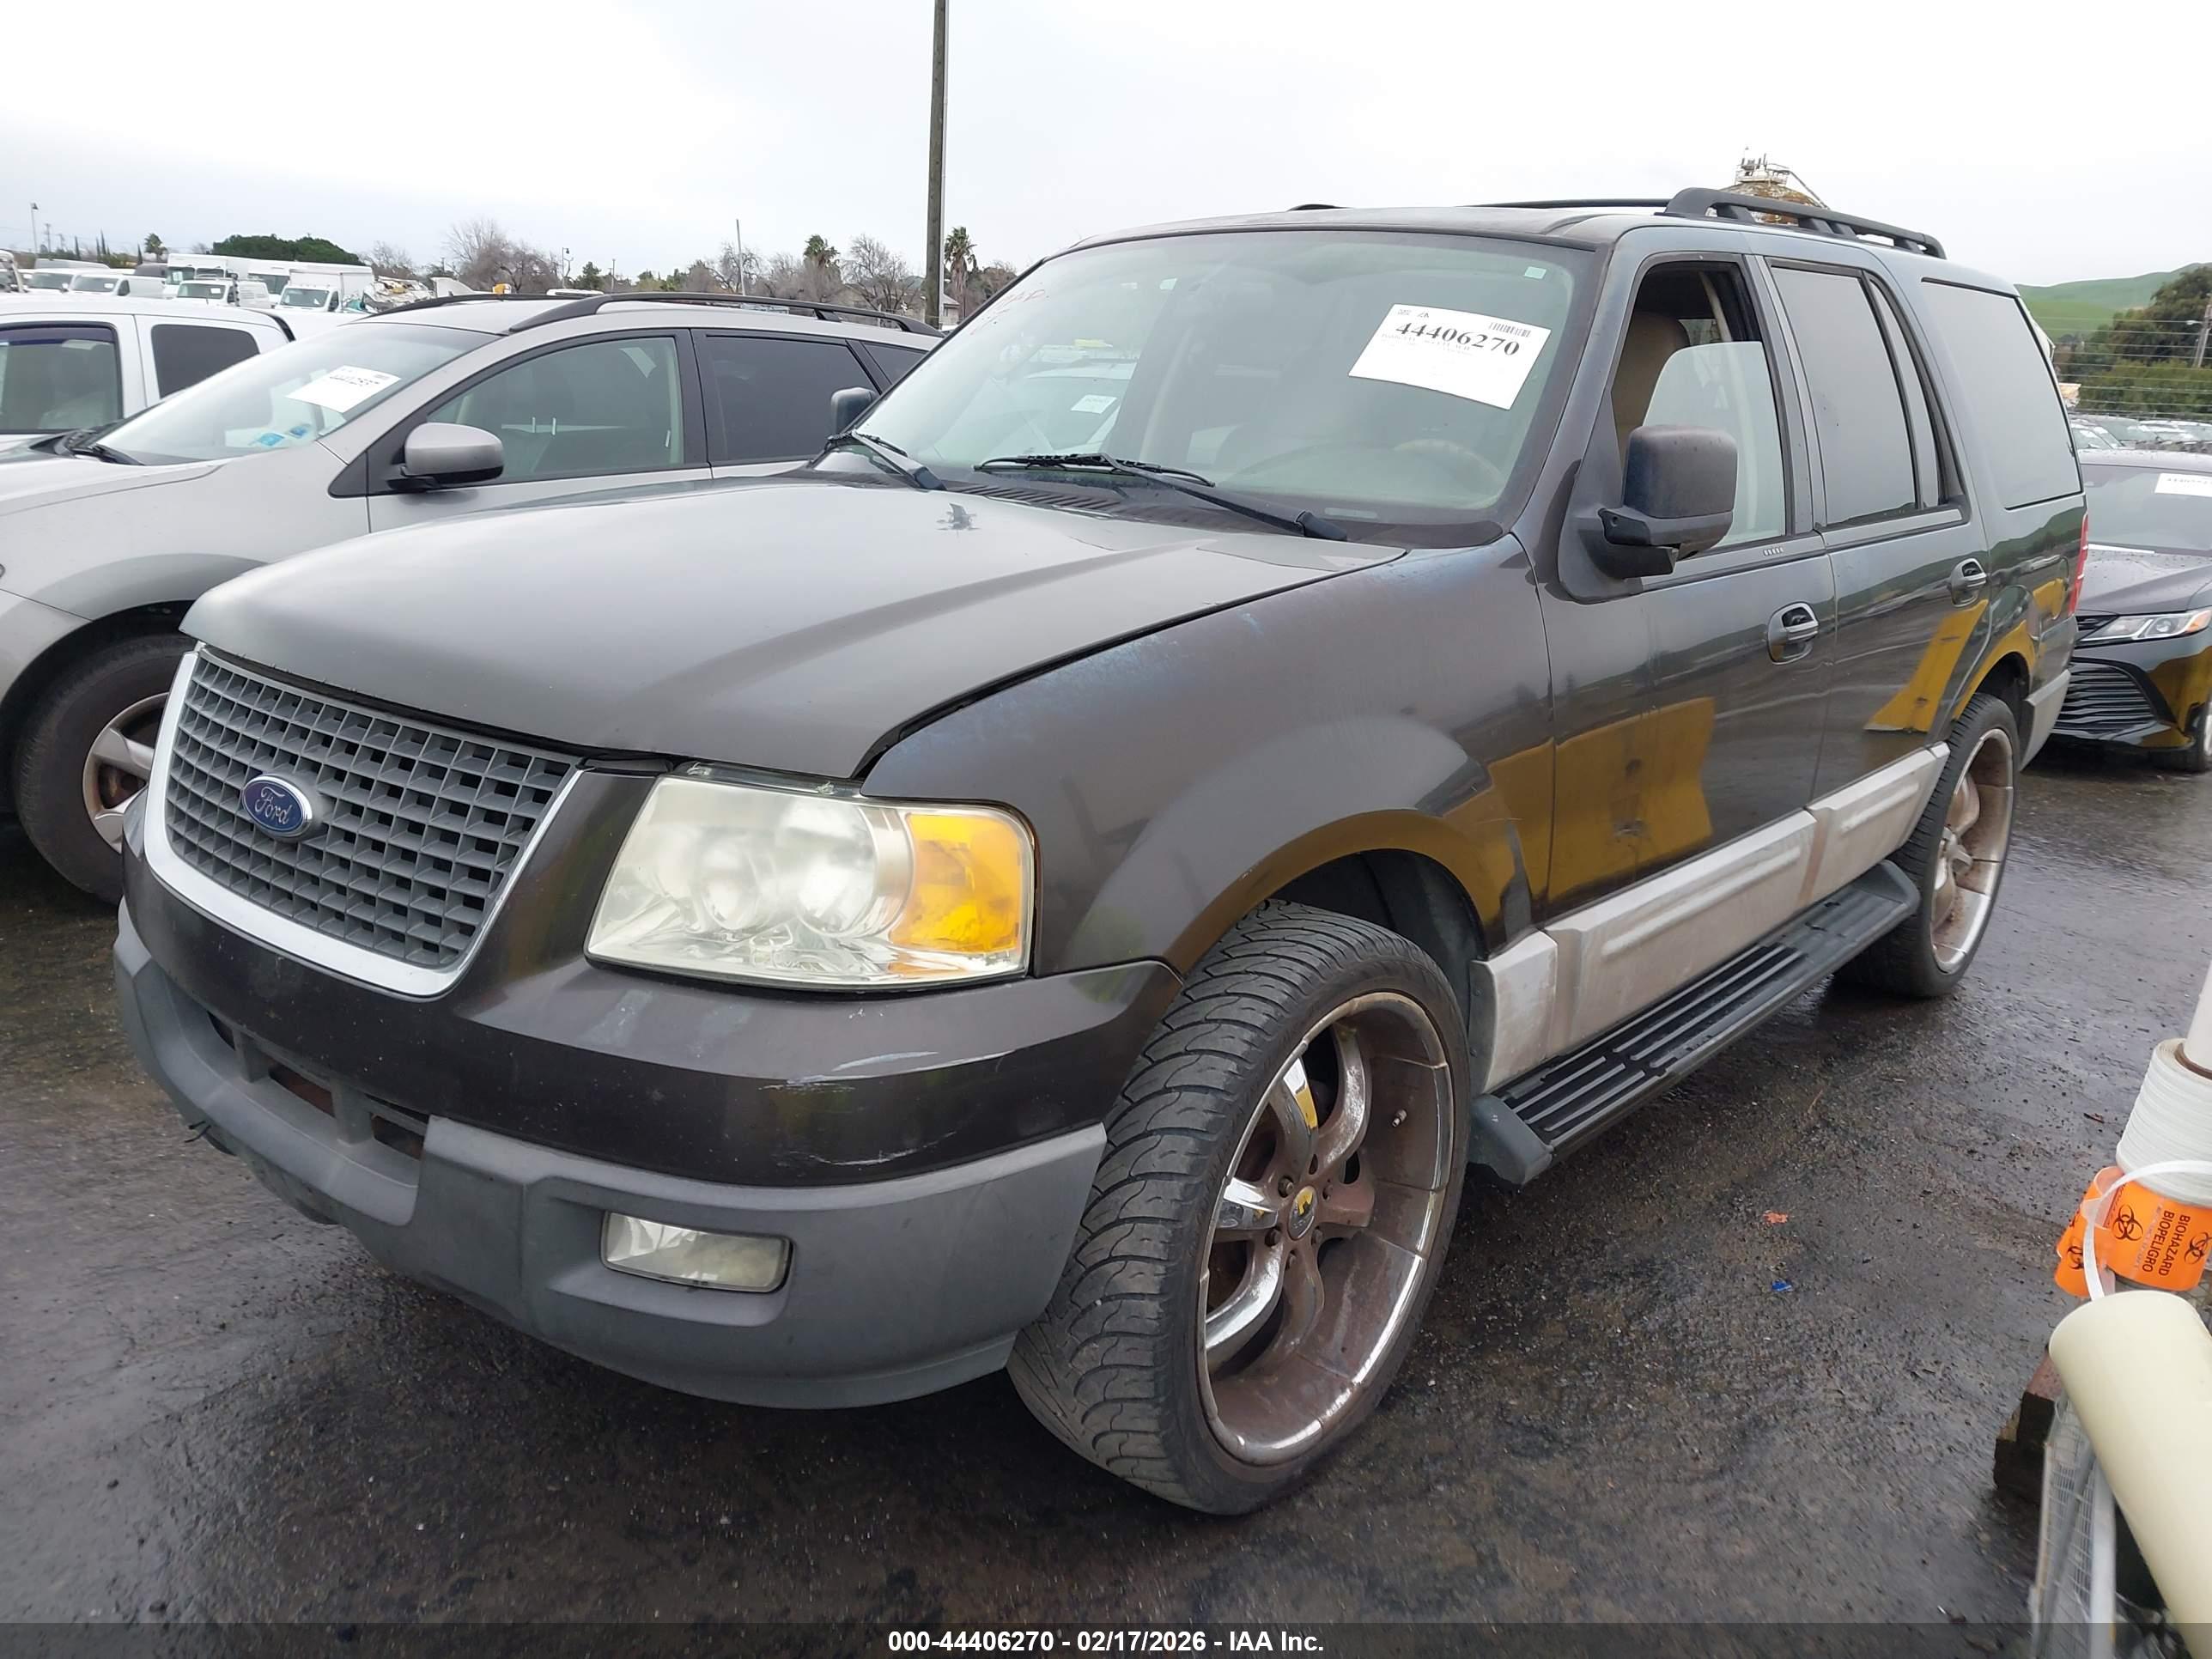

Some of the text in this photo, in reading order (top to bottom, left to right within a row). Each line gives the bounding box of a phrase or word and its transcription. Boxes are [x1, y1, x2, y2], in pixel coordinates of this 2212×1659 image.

[1395, 322, 1520, 356] 44406270
[254, 786, 293, 825] Ford
[2142, 1209, 2175, 1273] BIOPELIGRO
[2158, 1214, 2191, 1277] BIOHAZARD
